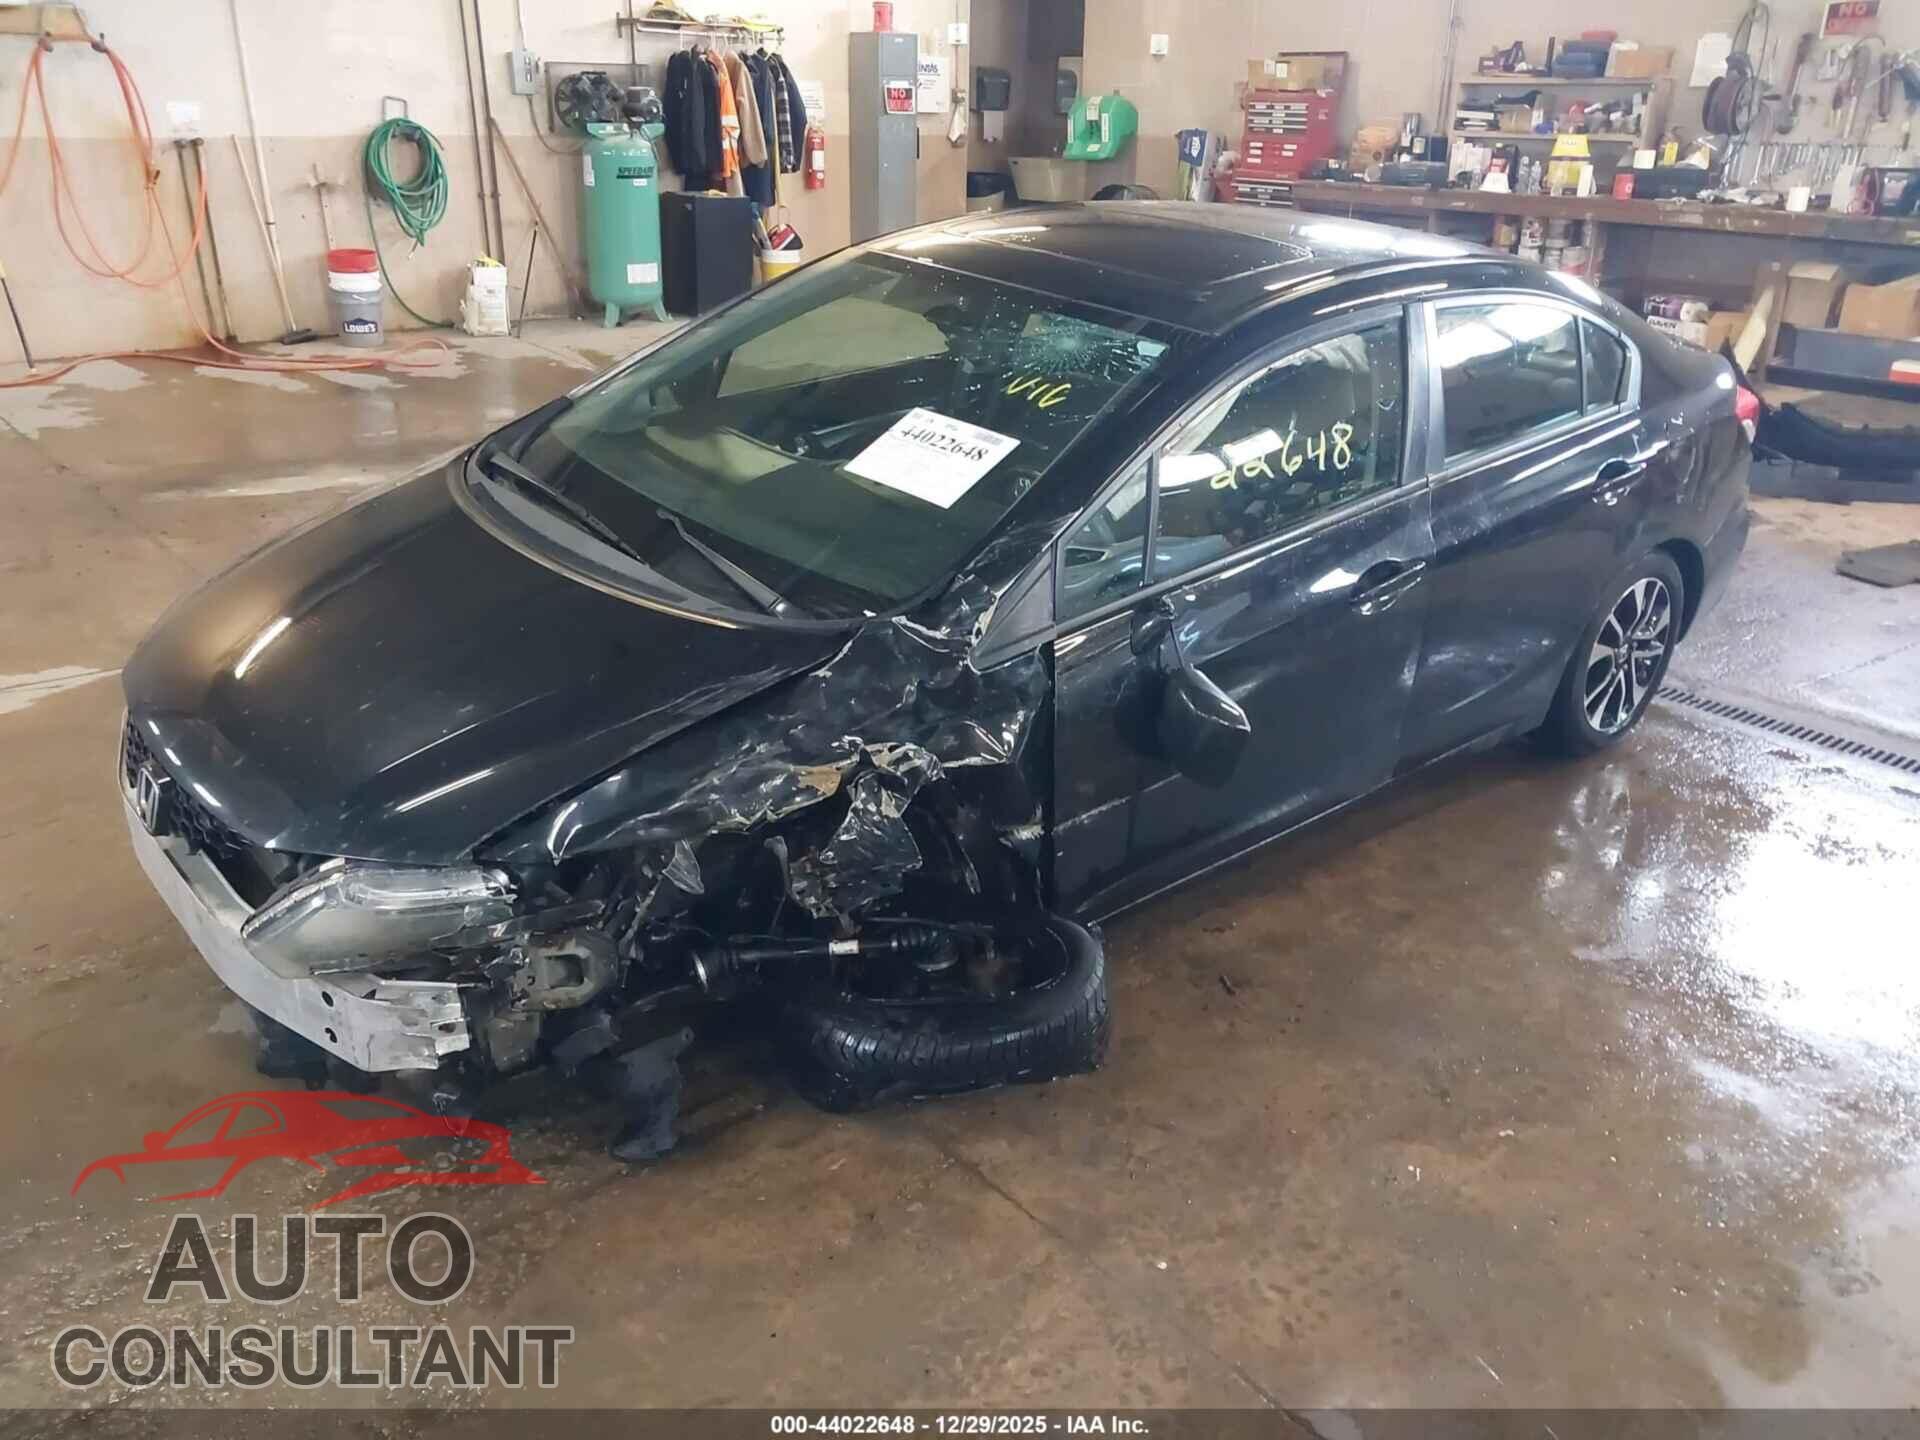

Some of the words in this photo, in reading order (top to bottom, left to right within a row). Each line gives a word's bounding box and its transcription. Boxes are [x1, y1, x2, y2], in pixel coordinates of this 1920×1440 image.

[1839, 2, 1867, 17] NO
[891, 89, 906, 98] NO
[900, 425, 989, 462] 44022648
